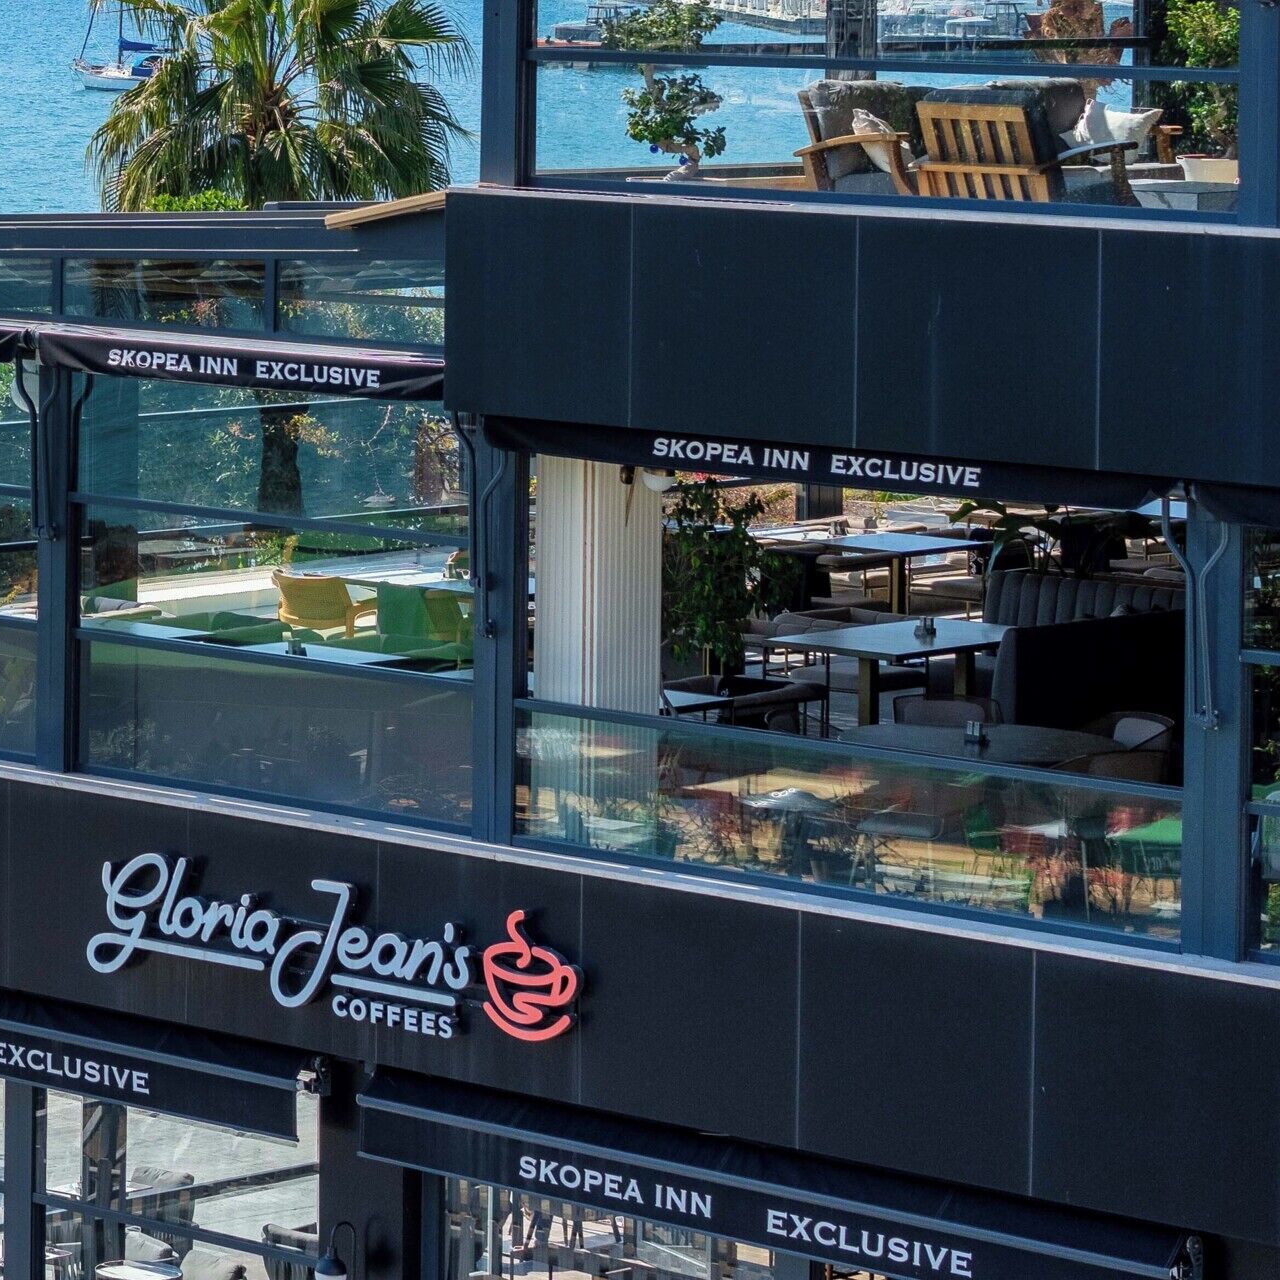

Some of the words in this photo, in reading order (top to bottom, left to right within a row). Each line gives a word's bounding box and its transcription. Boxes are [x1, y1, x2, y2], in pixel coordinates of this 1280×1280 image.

[107, 348, 192, 373] SKOPEA
[199, 355, 238, 376] INN
[255, 360, 381, 388] EXCLUSIVE
[652, 437, 754, 465] SKOPEA
[762, 448, 810, 471] INN
[830, 454, 982, 488] EXCLUSIVE
[86, 852, 280, 974] Gloria
[269, 879, 471, 1008] Jean's
[331, 994, 453, 1039] COFFEES
[519, 1155, 644, 1204] SKOPEA
[655, 1184, 713, 1220] INN
[766, 1208, 973, 1277] EXCLUSIVE
